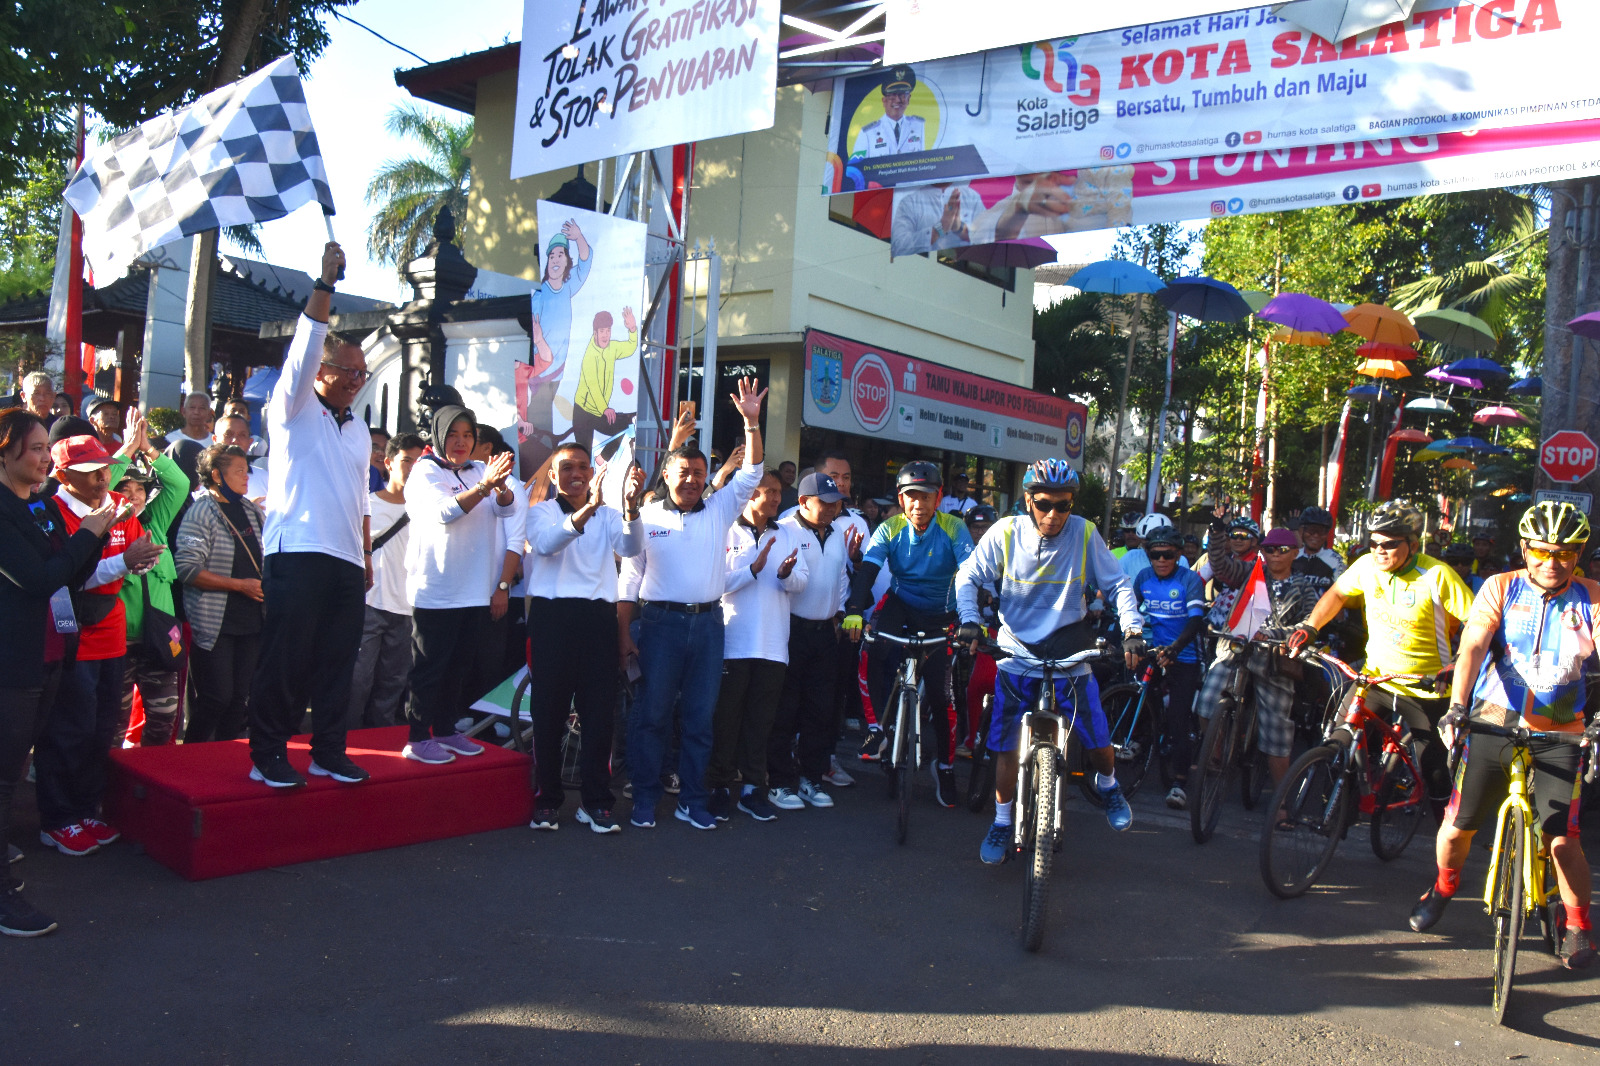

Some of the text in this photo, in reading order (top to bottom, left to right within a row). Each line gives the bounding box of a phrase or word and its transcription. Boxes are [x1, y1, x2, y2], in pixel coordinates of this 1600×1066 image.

[1121, 17, 1201, 47] Selamat
[1208, 10, 1249, 33] Hari
[543, 0, 757, 99] TOLAK GRATIFIKASI
[1118, 0, 1562, 91] KOTA SALATIGA
[529, 38, 758, 148] & STOP PENYUAPAN
[1017, 97, 1048, 112] Kota
[1116, 68, 1367, 118] Bersatu, Tumbuh dan Maju
[1016, 108, 1099, 132] Salatiga
[1136, 136, 1219, 154] @humaskotasalatiga
[1267, 128, 1297, 139] humas
[1299, 125, 1318, 136] kota
[1320, 122, 1356, 135] salatiga
[1369, 118, 1401, 130] BAGIAN
[1402, 114, 1448, 127] PROTOKOL
[1451, 112, 1459, 122] &
[1460, 106, 1518, 121] KOMUNIKASI
[1520, 101, 1568, 114] PIMPINAN
[1249, 191, 1336, 209] @humaskotasalatiga
[1387, 182, 1418, 192] humas
[1420, 179, 1440, 189] kota
[812, 346, 841, 359] SALATIGA
[857, 383, 886, 402] STOP
[926, 372, 1062, 420] TAMU WAJIB LAPOR POS PENJAGAAN
[954, 415, 969, 428] Mobil
[1033, 432, 1044, 443] STOP
[1544, 446, 1593, 466] STOP
[57, 620, 74, 628] CREW
